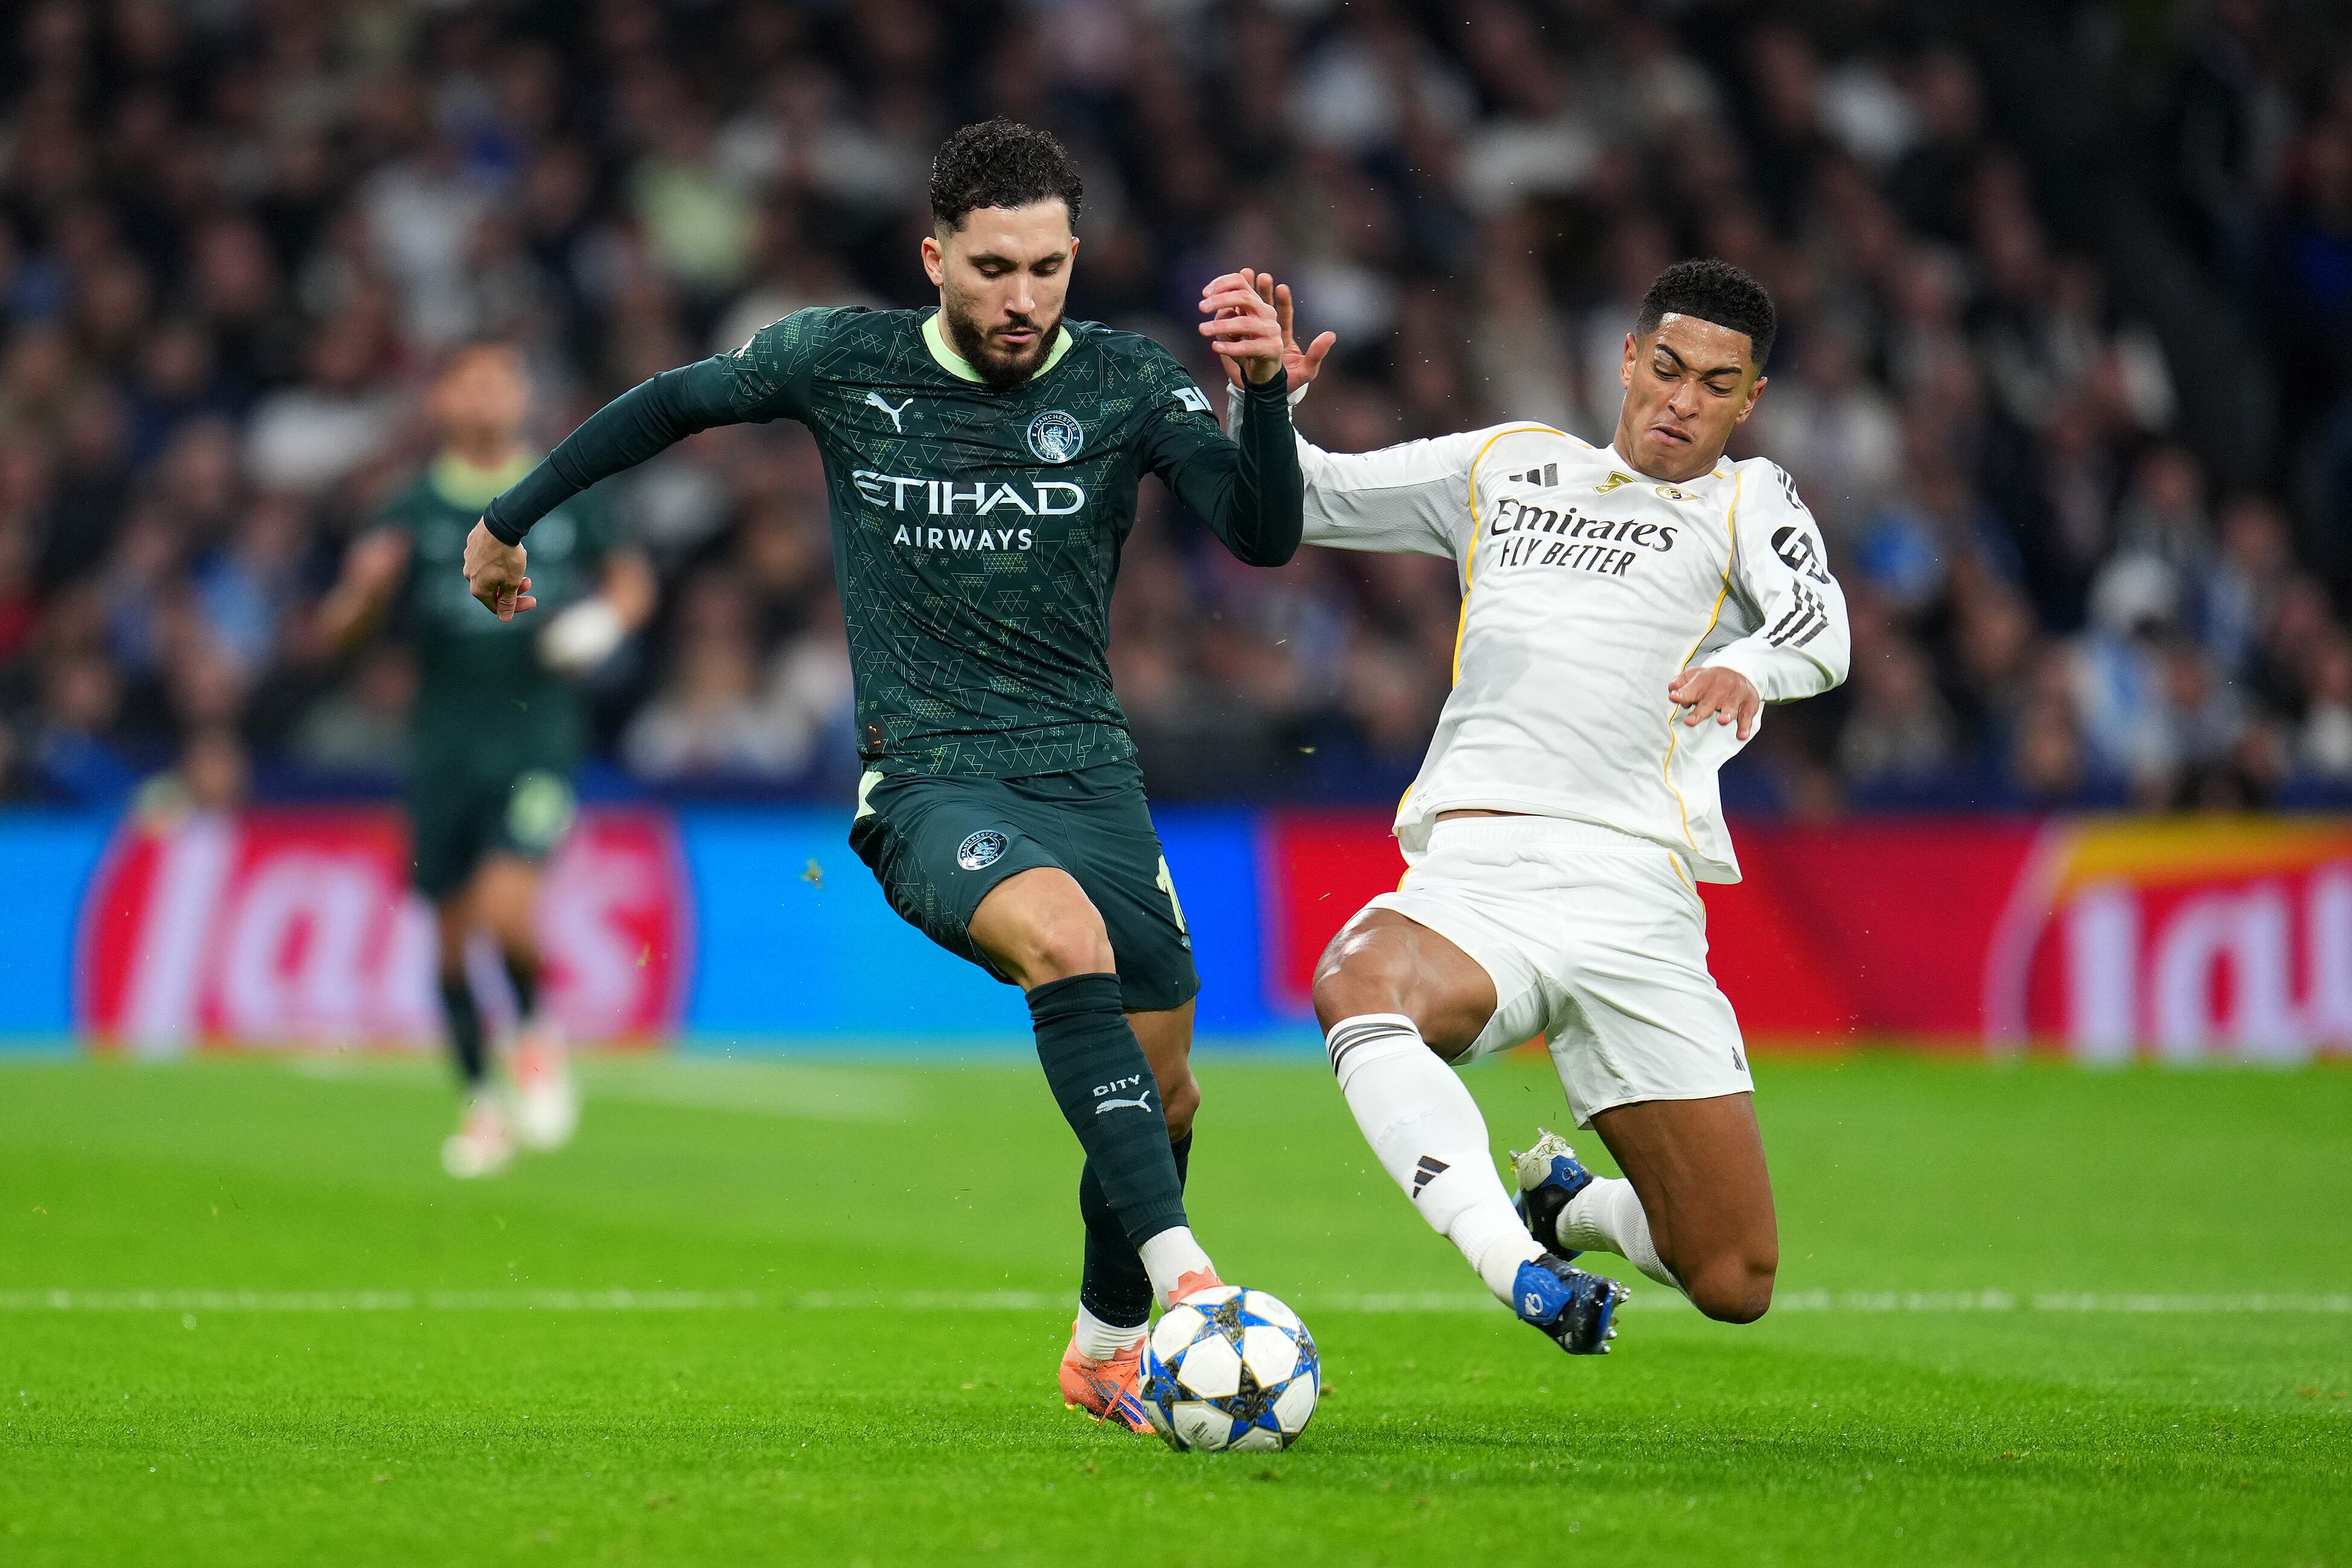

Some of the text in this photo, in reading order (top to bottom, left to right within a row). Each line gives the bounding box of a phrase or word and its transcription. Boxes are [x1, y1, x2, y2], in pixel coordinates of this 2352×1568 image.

[1034, 414, 1077, 432] MANCHESTER
[852, 469, 1085, 516] ETIHAD
[893, 524, 1032, 551] AIRWAYS
[1491, 498, 1678, 552] Emirates
[1500, 536, 1636, 578] FLY BETTER
[961, 833, 998, 857] MANCHESTER
[985, 853, 998, 863] CITY
[1092, 1074, 1141, 1097] CITY
